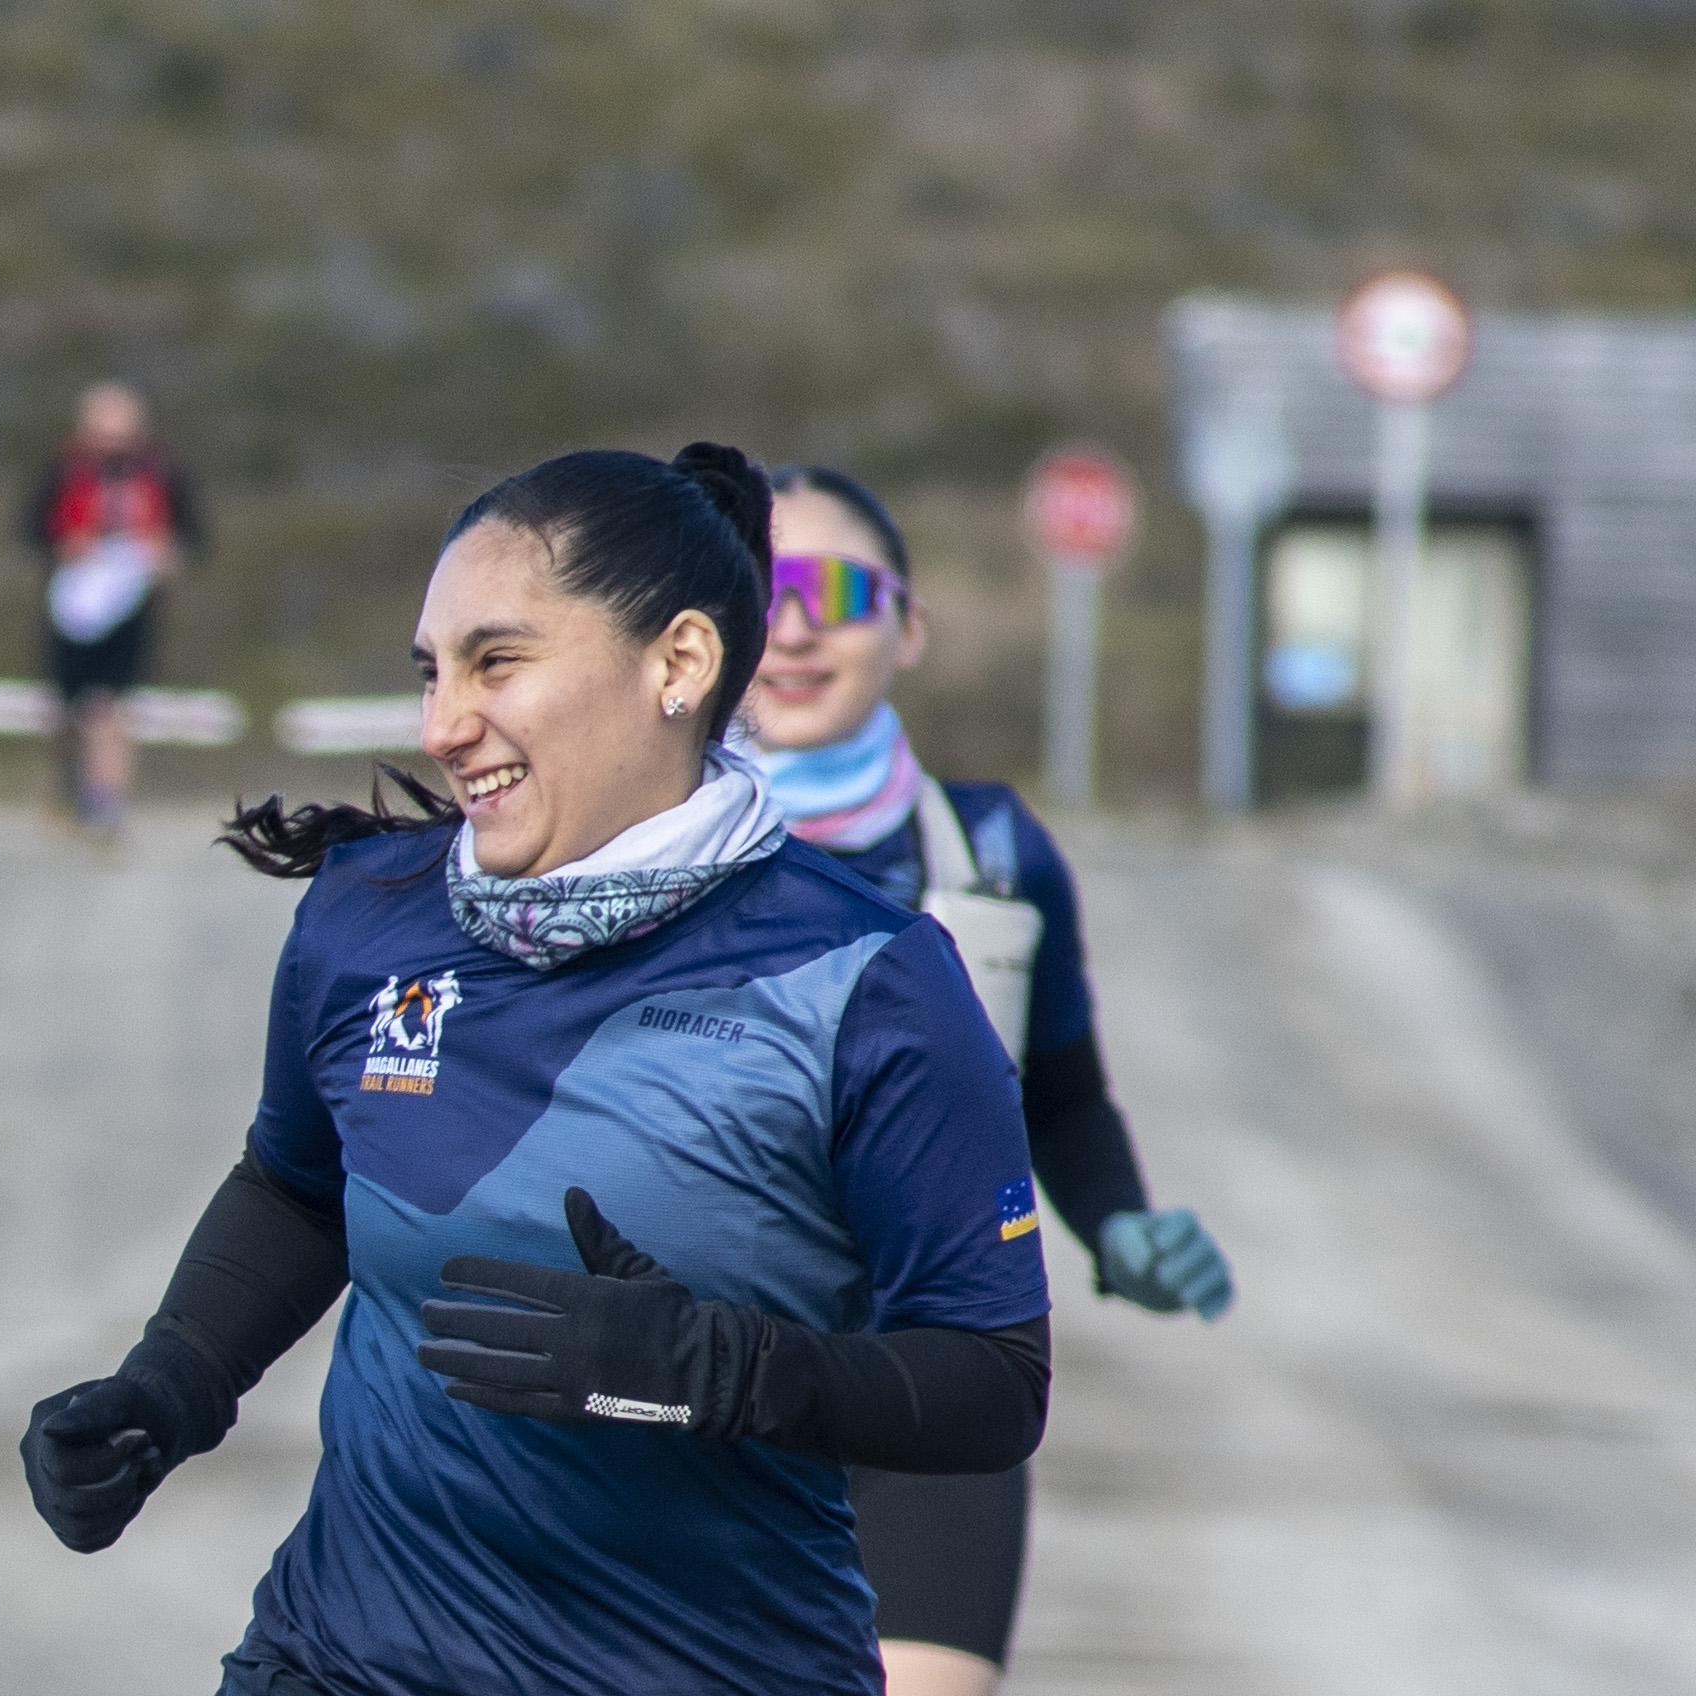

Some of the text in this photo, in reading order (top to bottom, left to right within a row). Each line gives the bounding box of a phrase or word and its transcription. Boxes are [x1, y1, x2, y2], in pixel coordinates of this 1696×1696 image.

[638, 1005, 745, 1043] BIORACER
[363, 1056, 440, 1078] MAGALLANES
[360, 1074, 435, 1096] TRAIL RUNNERS
